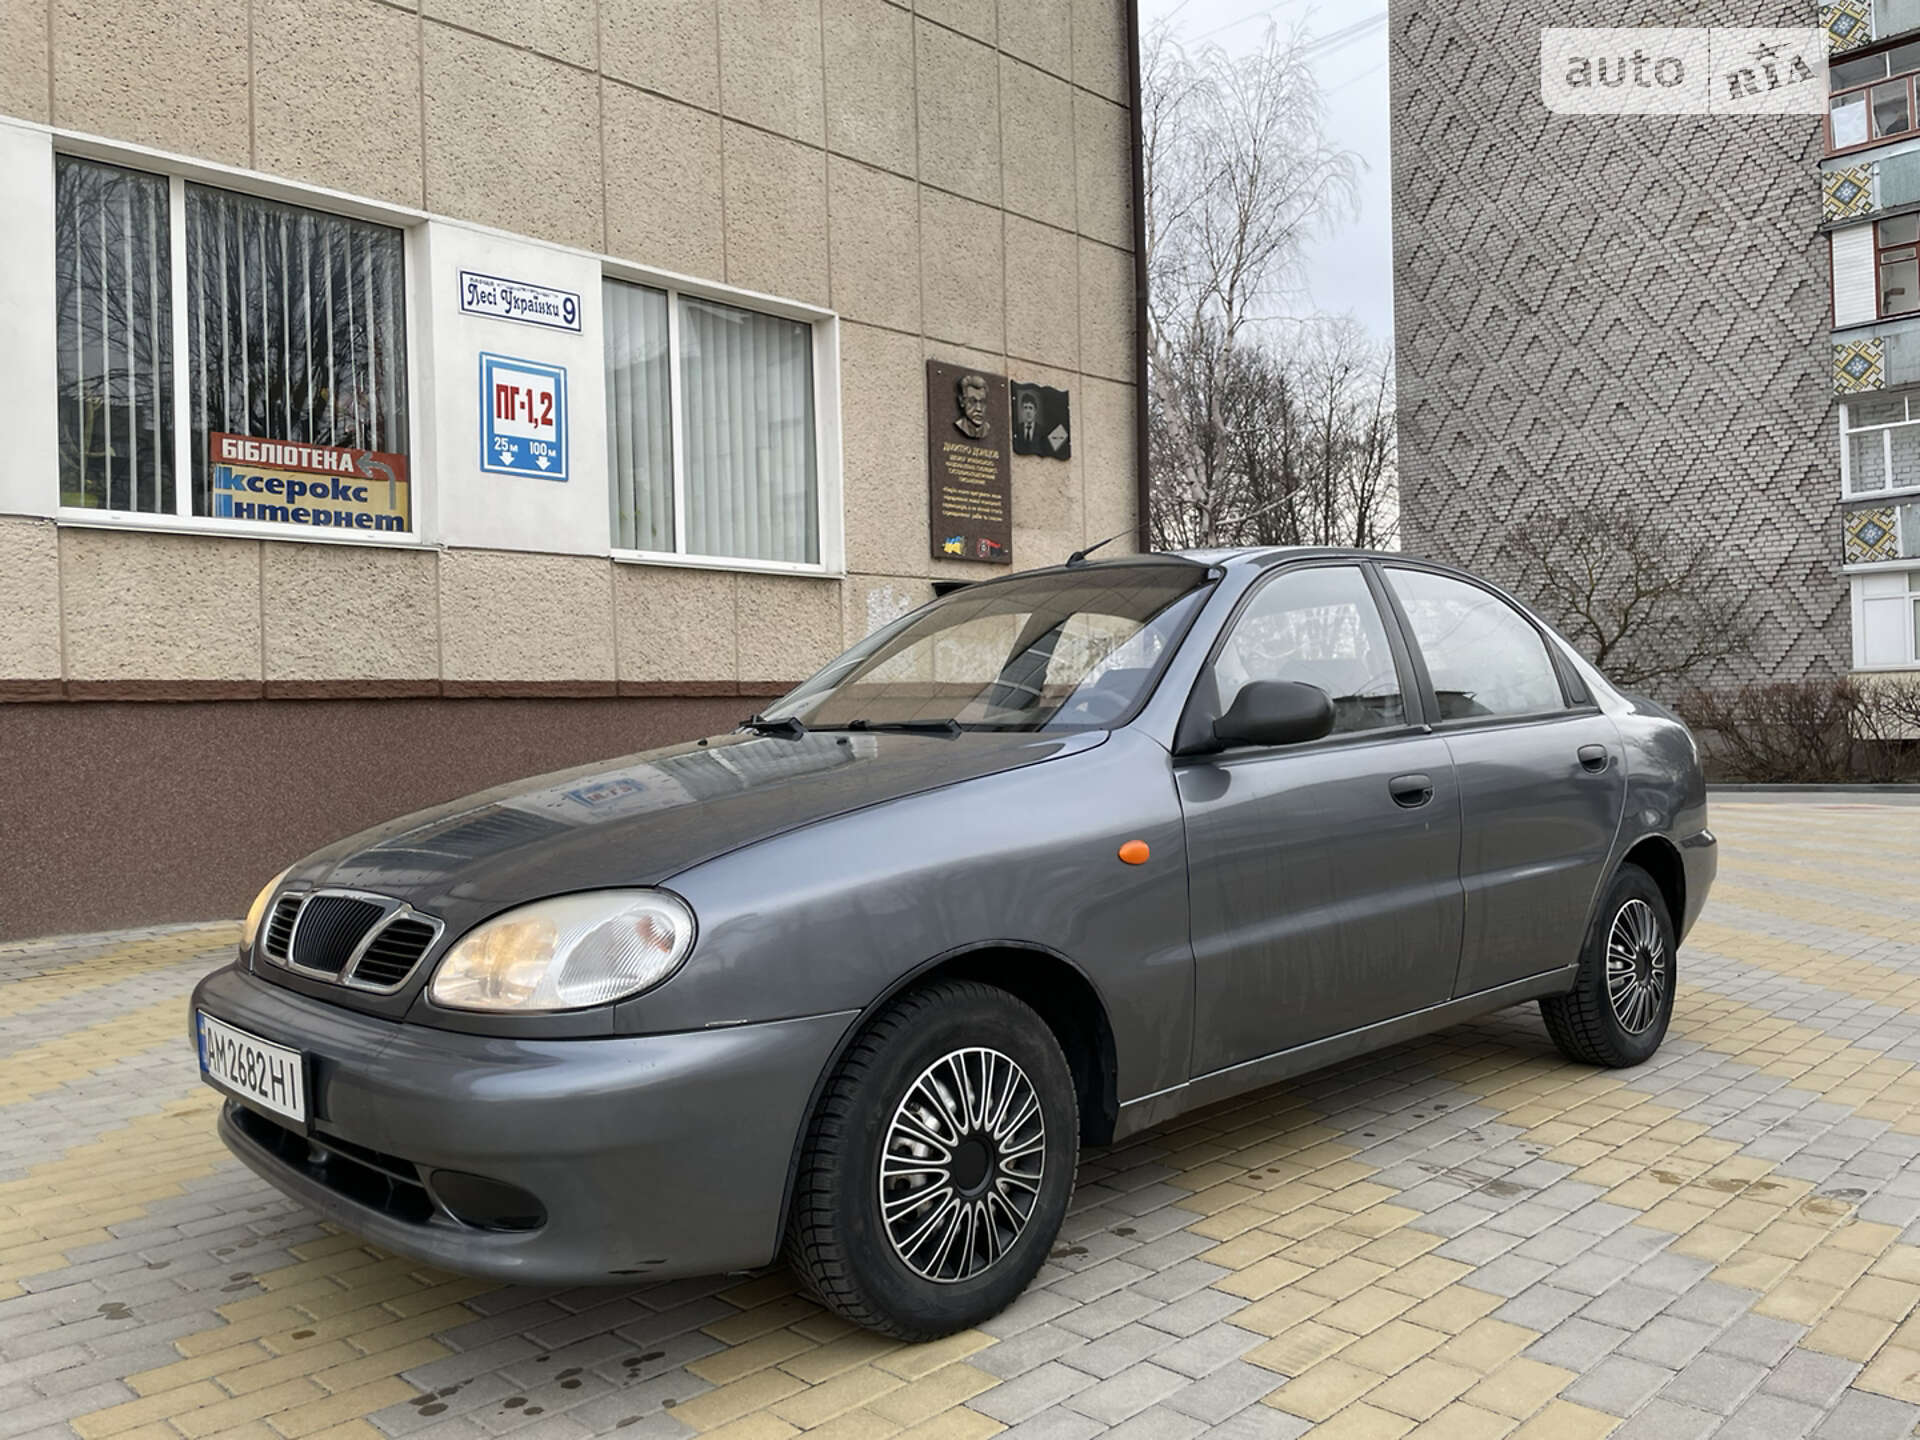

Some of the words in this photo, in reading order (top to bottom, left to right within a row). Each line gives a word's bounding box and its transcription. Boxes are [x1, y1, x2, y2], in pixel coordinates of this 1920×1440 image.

[467, 282, 497, 306] Лесі
[500, 288, 559, 317] Українки
[562, 296, 576, 325] 9
[495, 383, 553, 429] ПГ-1,2
